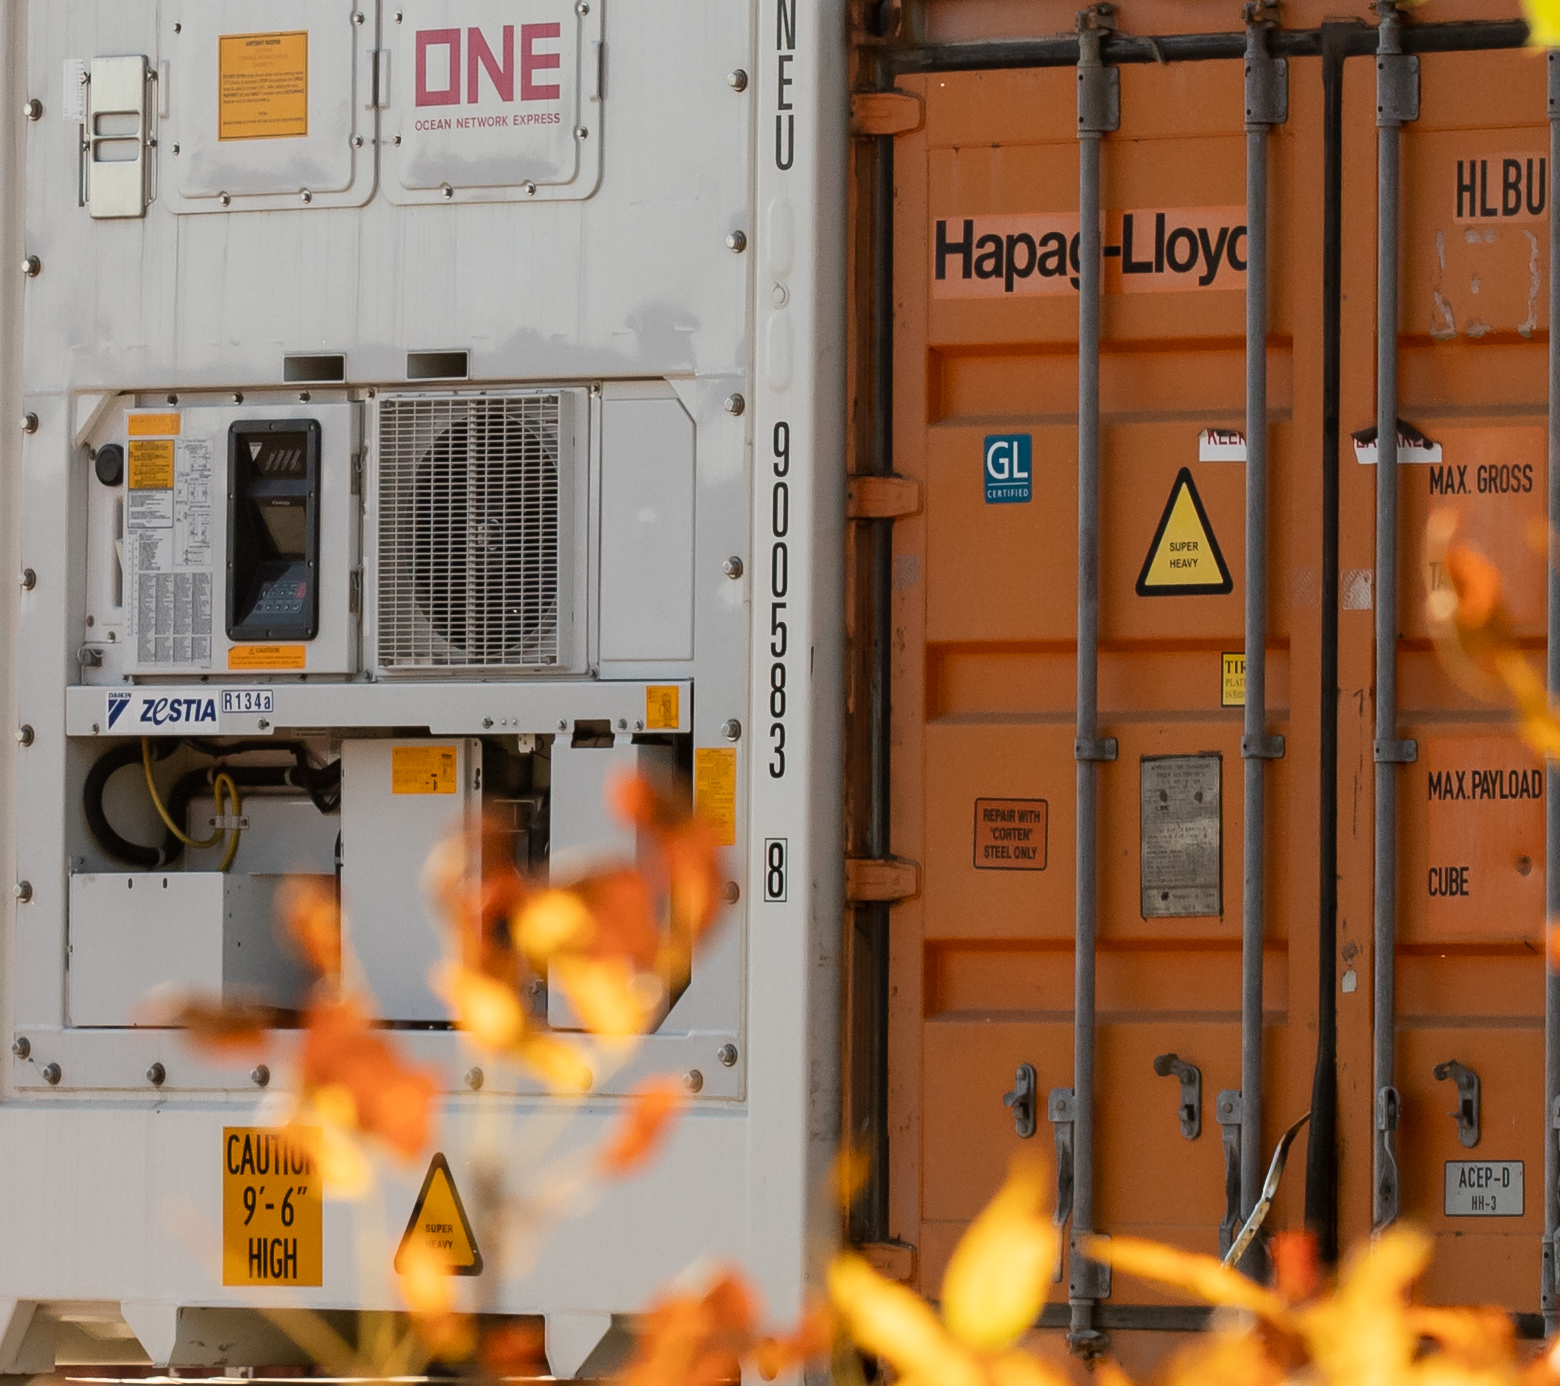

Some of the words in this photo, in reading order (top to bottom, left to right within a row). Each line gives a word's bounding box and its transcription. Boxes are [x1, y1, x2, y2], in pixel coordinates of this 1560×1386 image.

[415, 22, 561, 107] ONE
[414, 118, 452, 132] OCEAN
[455, 115, 509, 129] NETWORK
[512, 112, 561, 126] EXPRESS
[1456, 157, 1546, 218] HLBU
[986, 440, 1028, 480] GL
[1429, 464, 1471, 495] MAX.
[1477, 463, 1533, 495] GROSS
[986, 488, 1029, 499] CERTIFIED
[1169, 541, 1199, 552] SUPER
[1169, 558, 1199, 569] HEAVY
[769, 420, 792, 781] 900583
[224, 691, 271, 711] R134a
[1428, 769, 1543, 800] MAX.PAYLOAD
[983, 807, 1016, 823] REPAIR
[1017, 809, 1041, 824] WITH
[983, 845, 1012, 859] STEEL
[1013, 845, 1038, 861] ONLY
[768, 842, 785, 900] 8
[1428, 866, 1470, 896] CUBE
[227, 1133, 311, 1176] CAUTIO
[1458, 1166, 1511, 1188] ACEP-D
[1471, 1195, 1497, 1211] HH-3
[425, 1223, 454, 1235] SUPER
[248, 1237, 298, 1280] HIGH
